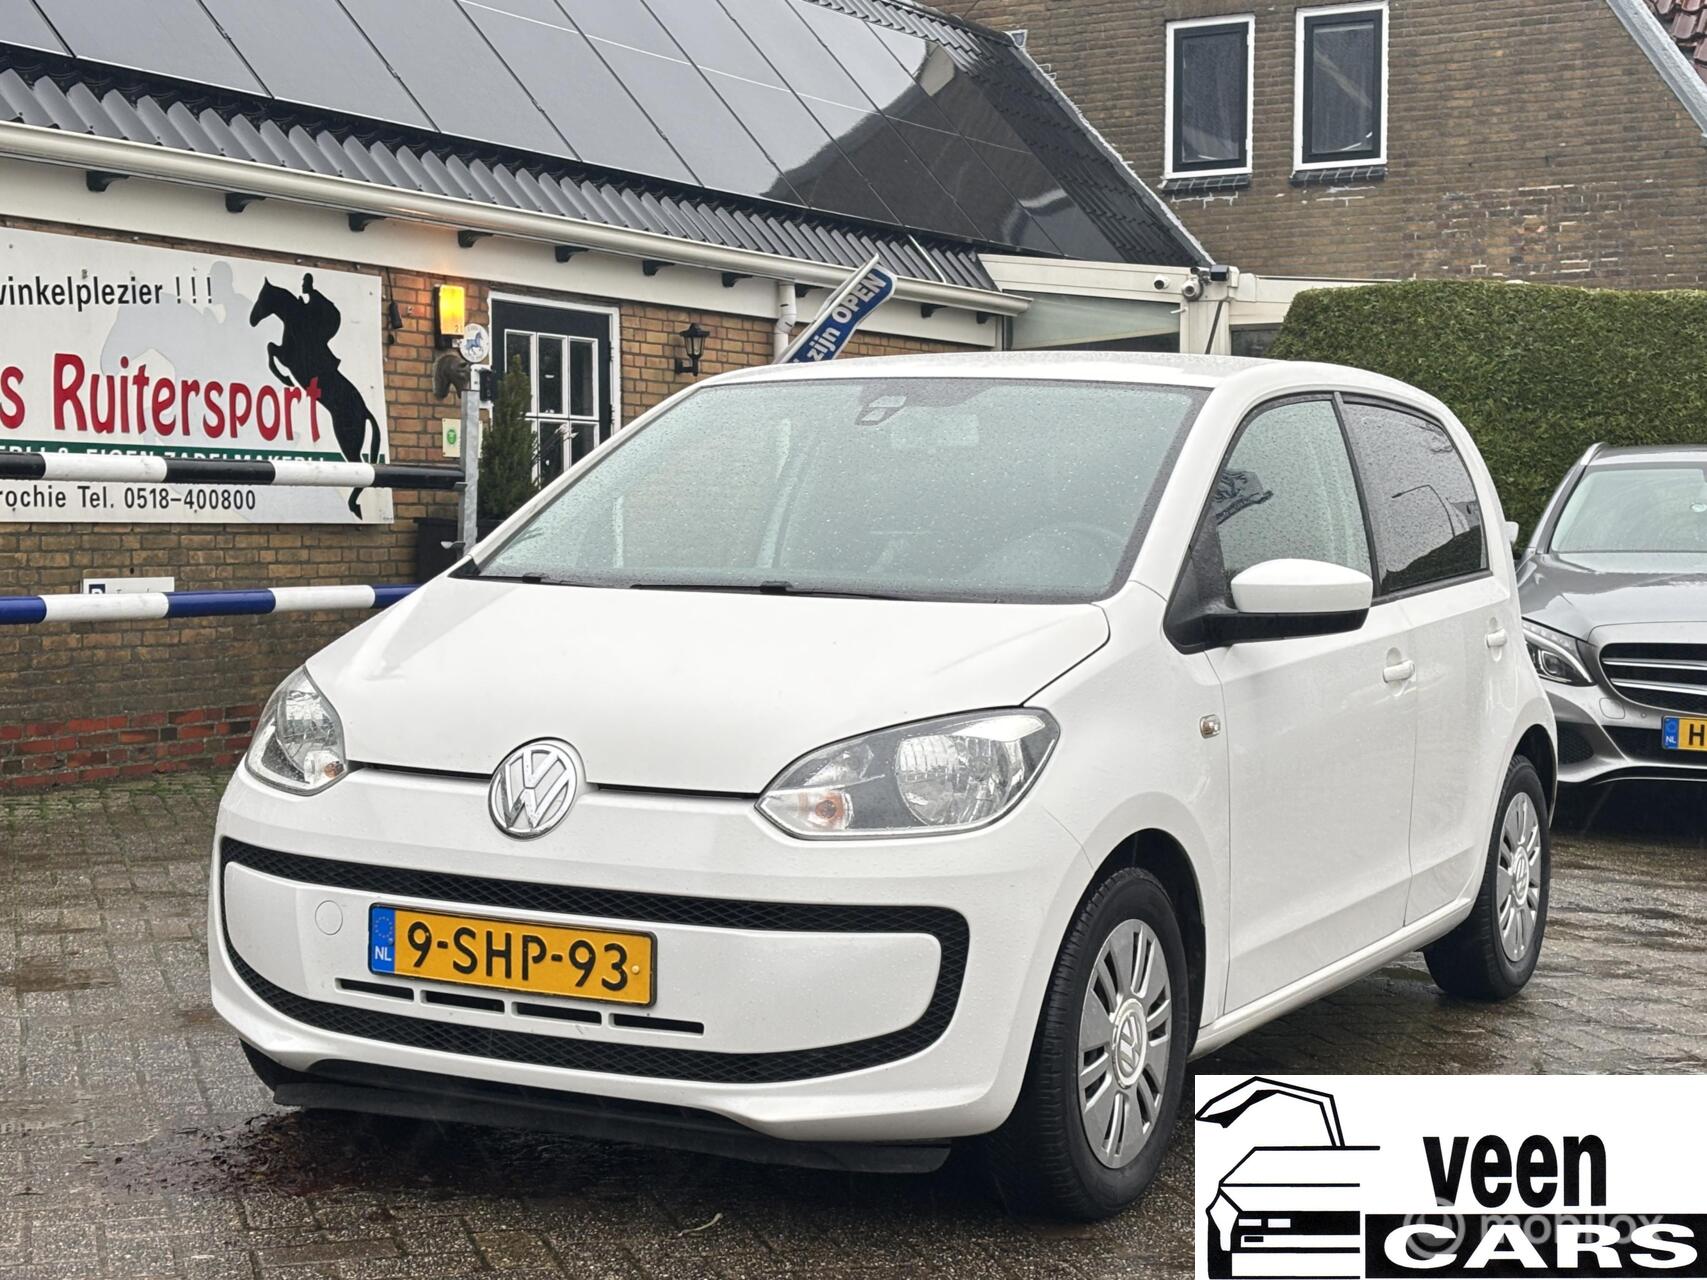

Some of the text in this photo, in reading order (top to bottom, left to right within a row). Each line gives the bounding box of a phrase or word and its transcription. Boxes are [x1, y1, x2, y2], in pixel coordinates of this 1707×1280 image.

[807, 272, 887, 361] zijn OPEN
[53, 352, 322, 443] Ruitersport
[77, 485, 115, 509] Tel.
[124, 487, 256, 510] 0518-400800
[1665, 735, 1677, 744] NL
[374, 921, 629, 992] NL 9-SHP-93
